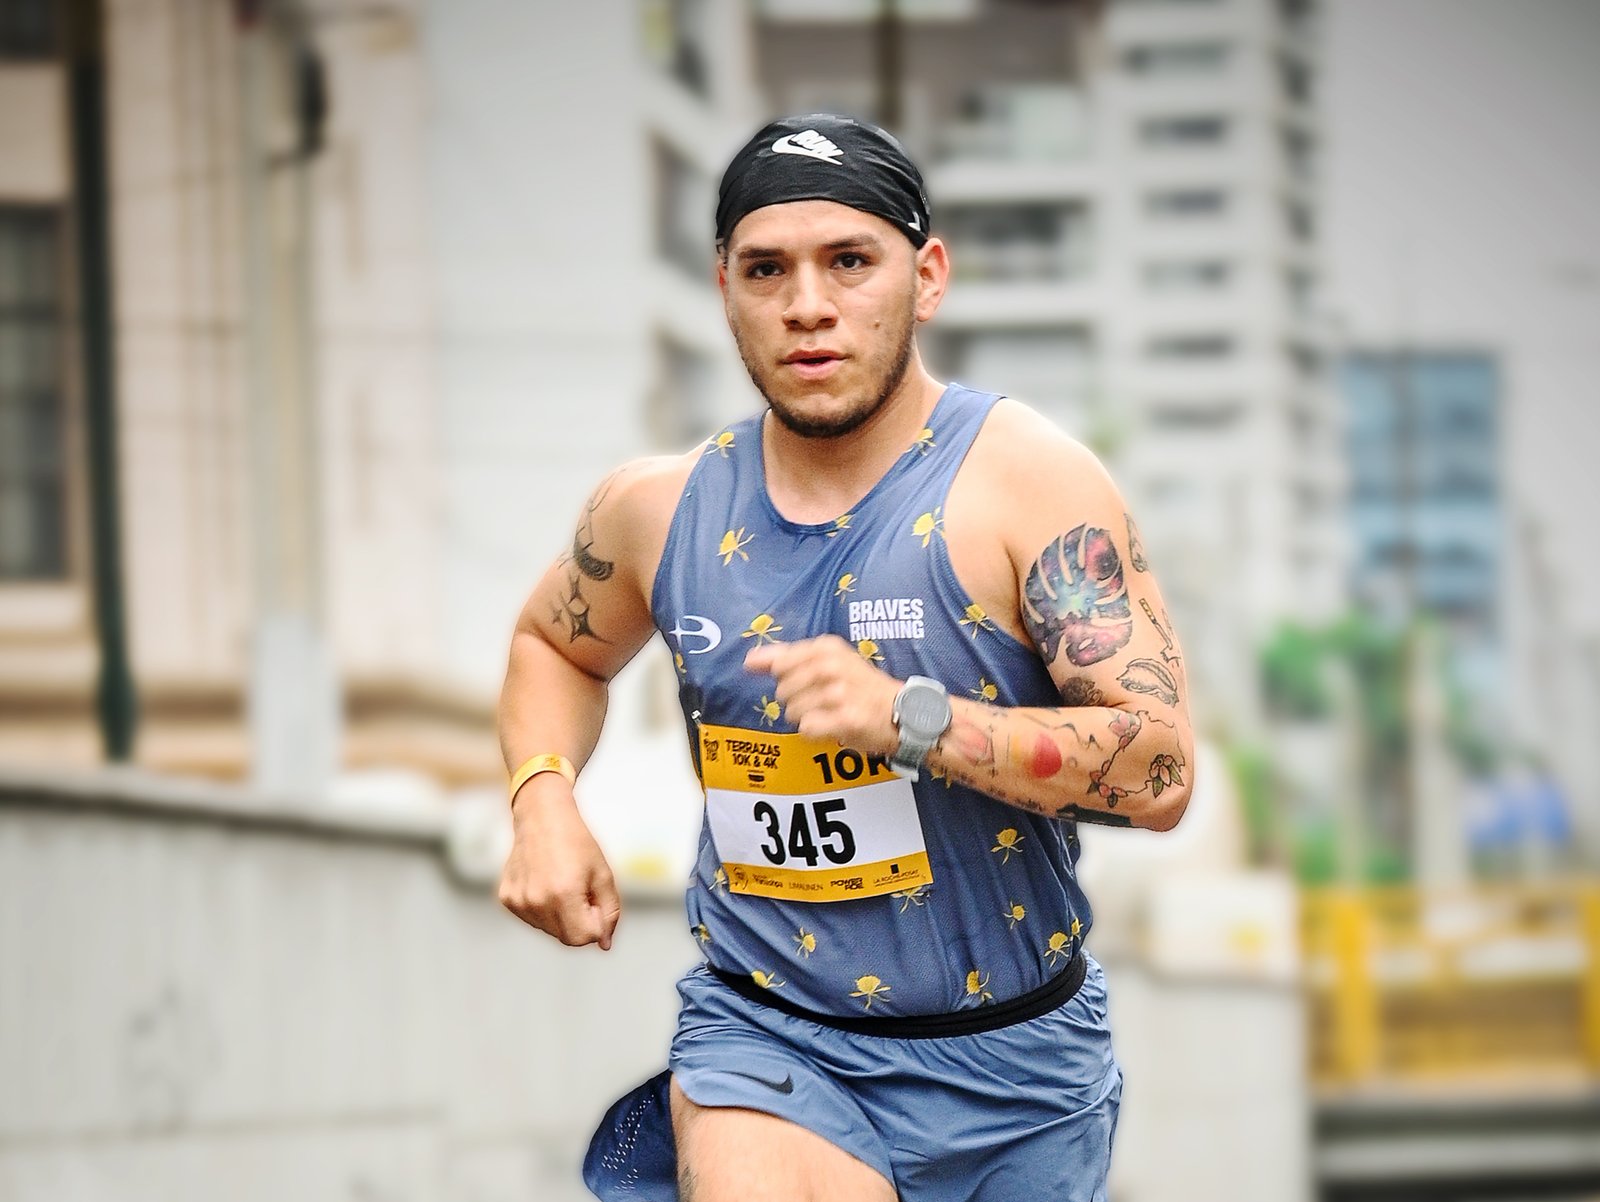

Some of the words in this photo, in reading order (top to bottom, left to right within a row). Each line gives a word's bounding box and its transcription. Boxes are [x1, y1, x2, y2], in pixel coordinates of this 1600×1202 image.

[848, 598, 924, 623] BRAVES
[849, 620, 925, 642] RUNNING
[725, 738, 781, 757] TERRAZAS
[732, 752, 751, 767] 10K
[754, 755, 761, 767] &
[763, 756, 778, 769] 4K
[753, 798, 856, 867] 345
